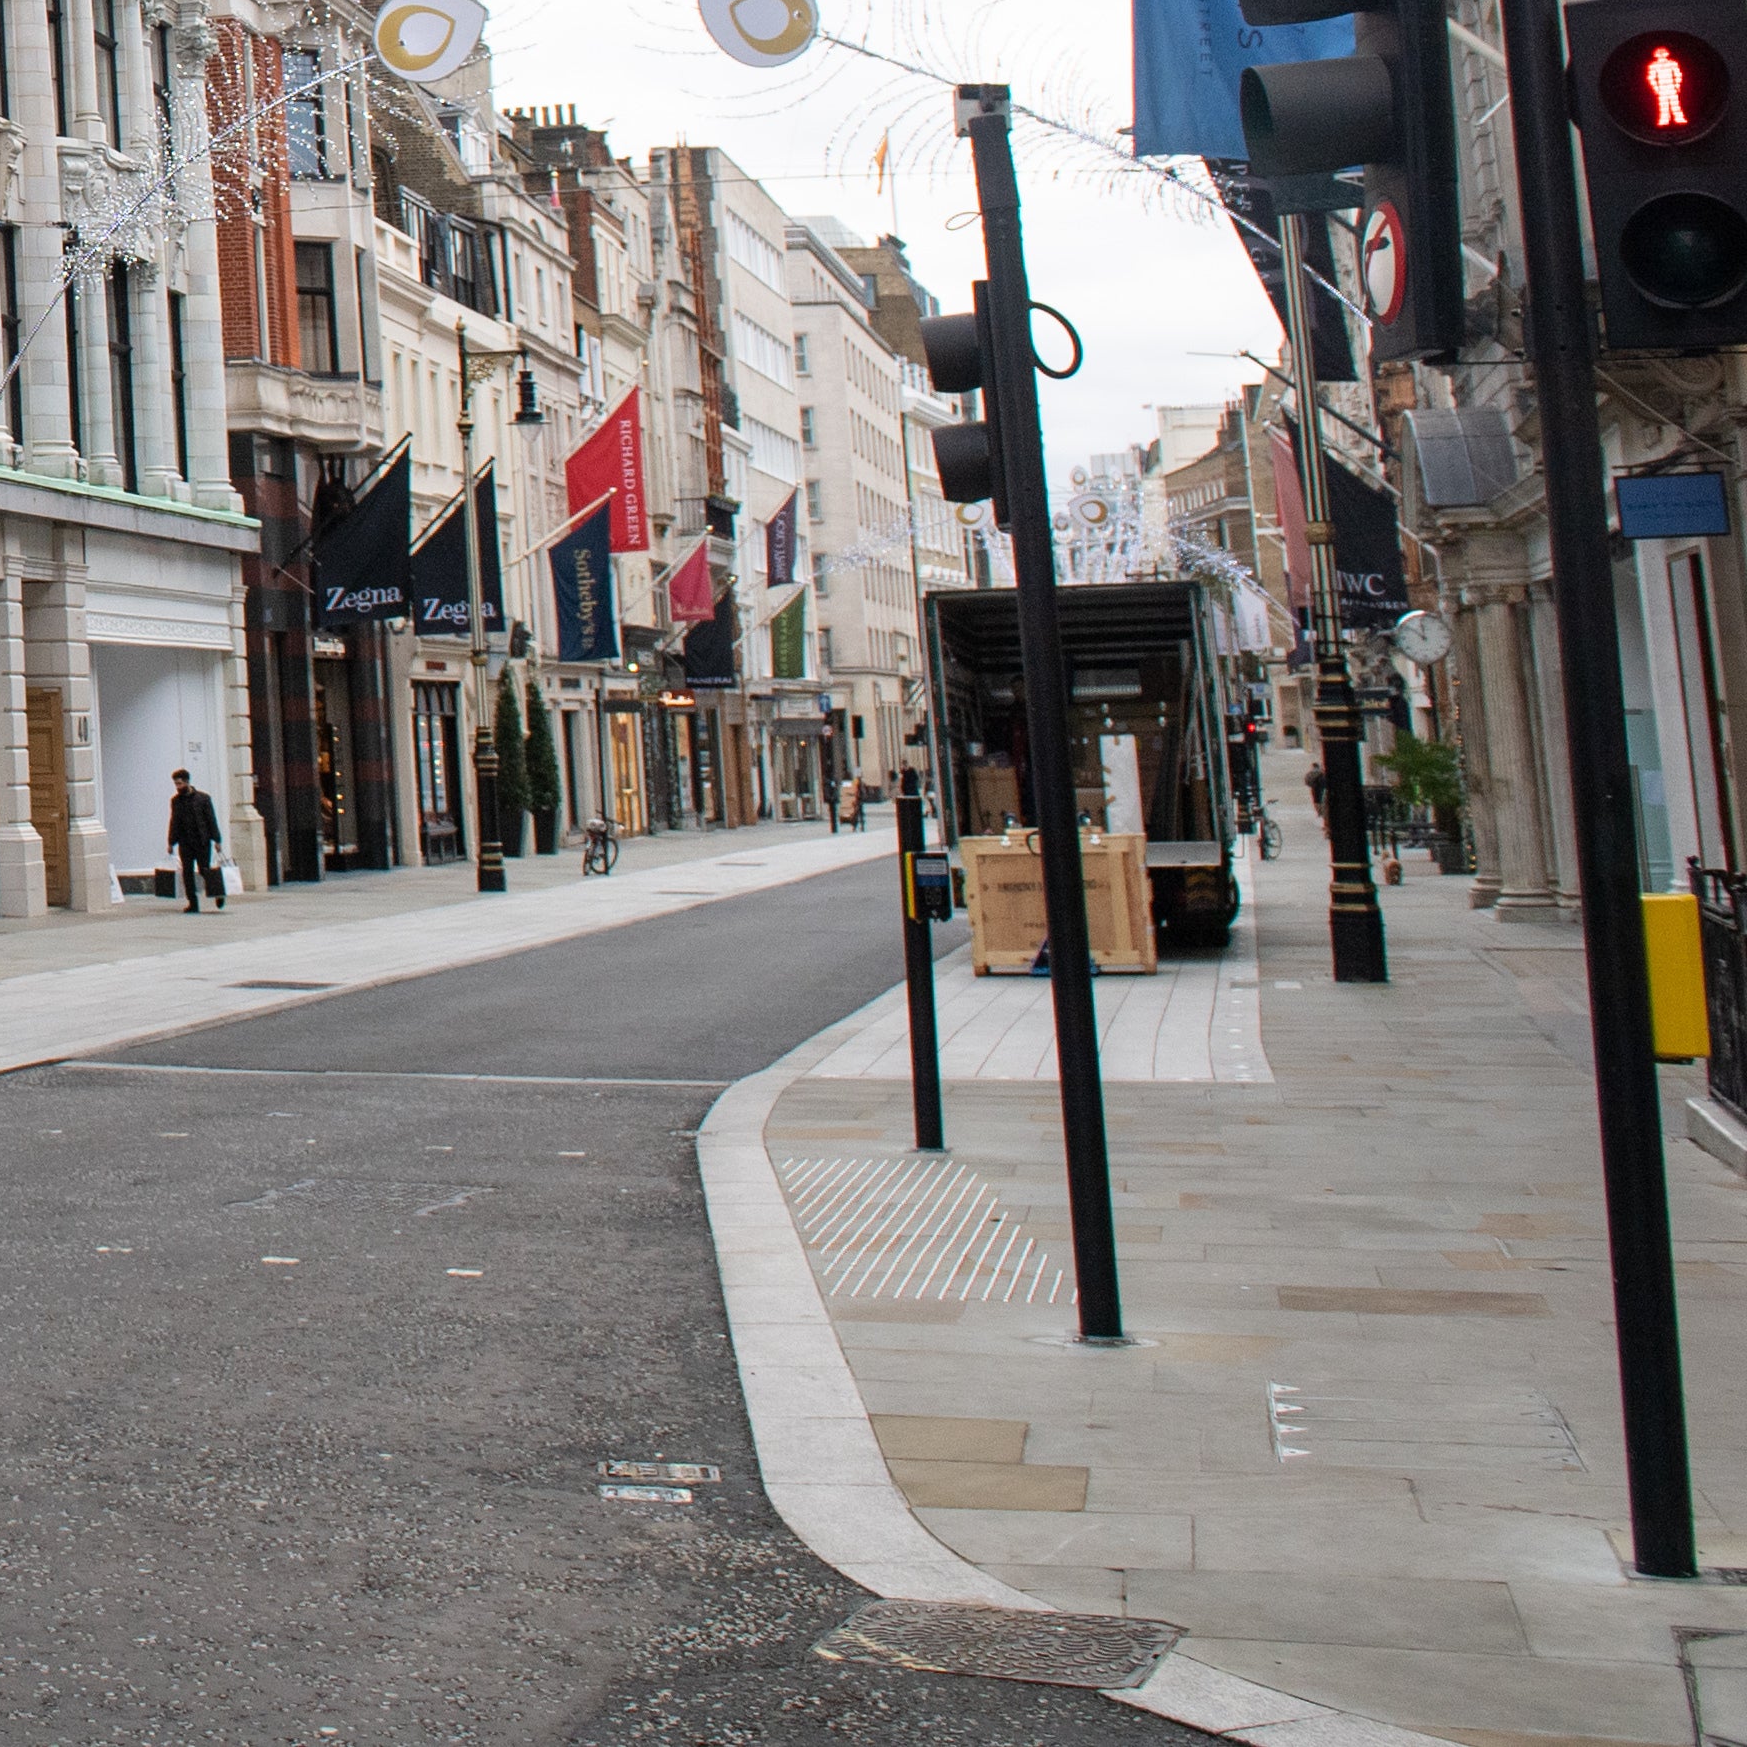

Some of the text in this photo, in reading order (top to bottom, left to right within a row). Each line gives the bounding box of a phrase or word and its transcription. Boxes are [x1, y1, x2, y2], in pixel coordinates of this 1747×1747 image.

[619, 419, 641, 546] RICHARD GREEN
[574, 548, 600, 637] Sotheby's
[1336, 569, 1387, 596] IWC
[325, 586, 405, 613] Zegna
[423, 598, 496, 625] Zega
